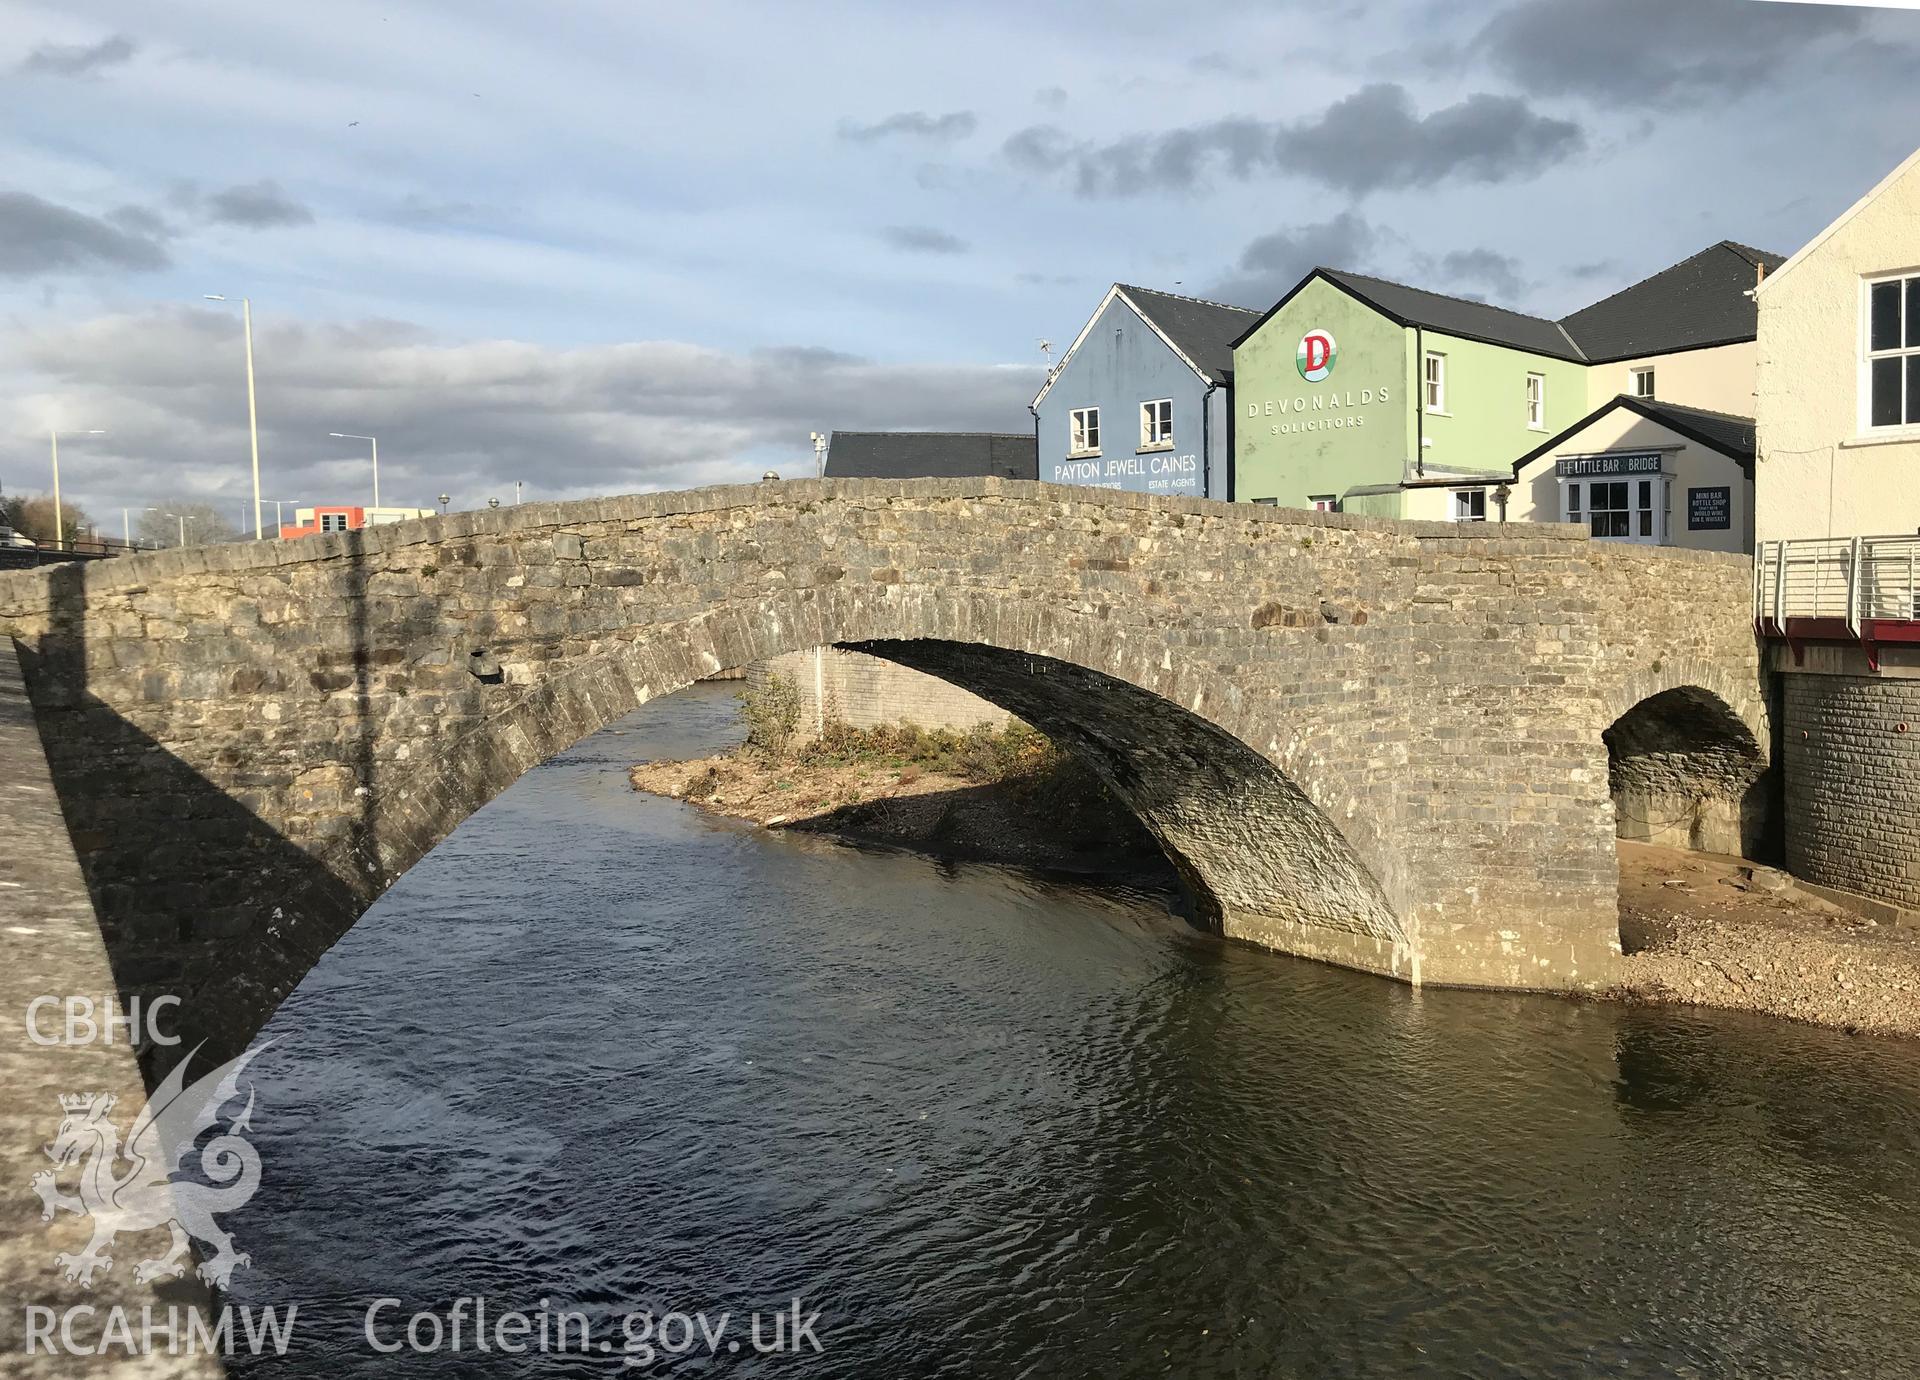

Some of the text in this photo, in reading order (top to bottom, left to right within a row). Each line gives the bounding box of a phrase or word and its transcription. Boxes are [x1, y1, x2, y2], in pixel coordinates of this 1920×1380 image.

[1304, 335, 1331, 372] D
[1248, 386, 1390, 418] DEVONALDS
[1271, 416, 1364, 435] SOLICITORS
[1055, 455, 1196, 480] PAYTON JEWELL CAINES
[1558, 461, 1574, 475] THE
[1575, 460, 1601, 474] LITTLE
[1603, 459, 1619, 472] BAR
[1628, 457, 1658, 471] BRIDGE
[1148, 478, 1196, 489] ESTATE AGENTS
[1710, 491, 1722, 499] BAR
